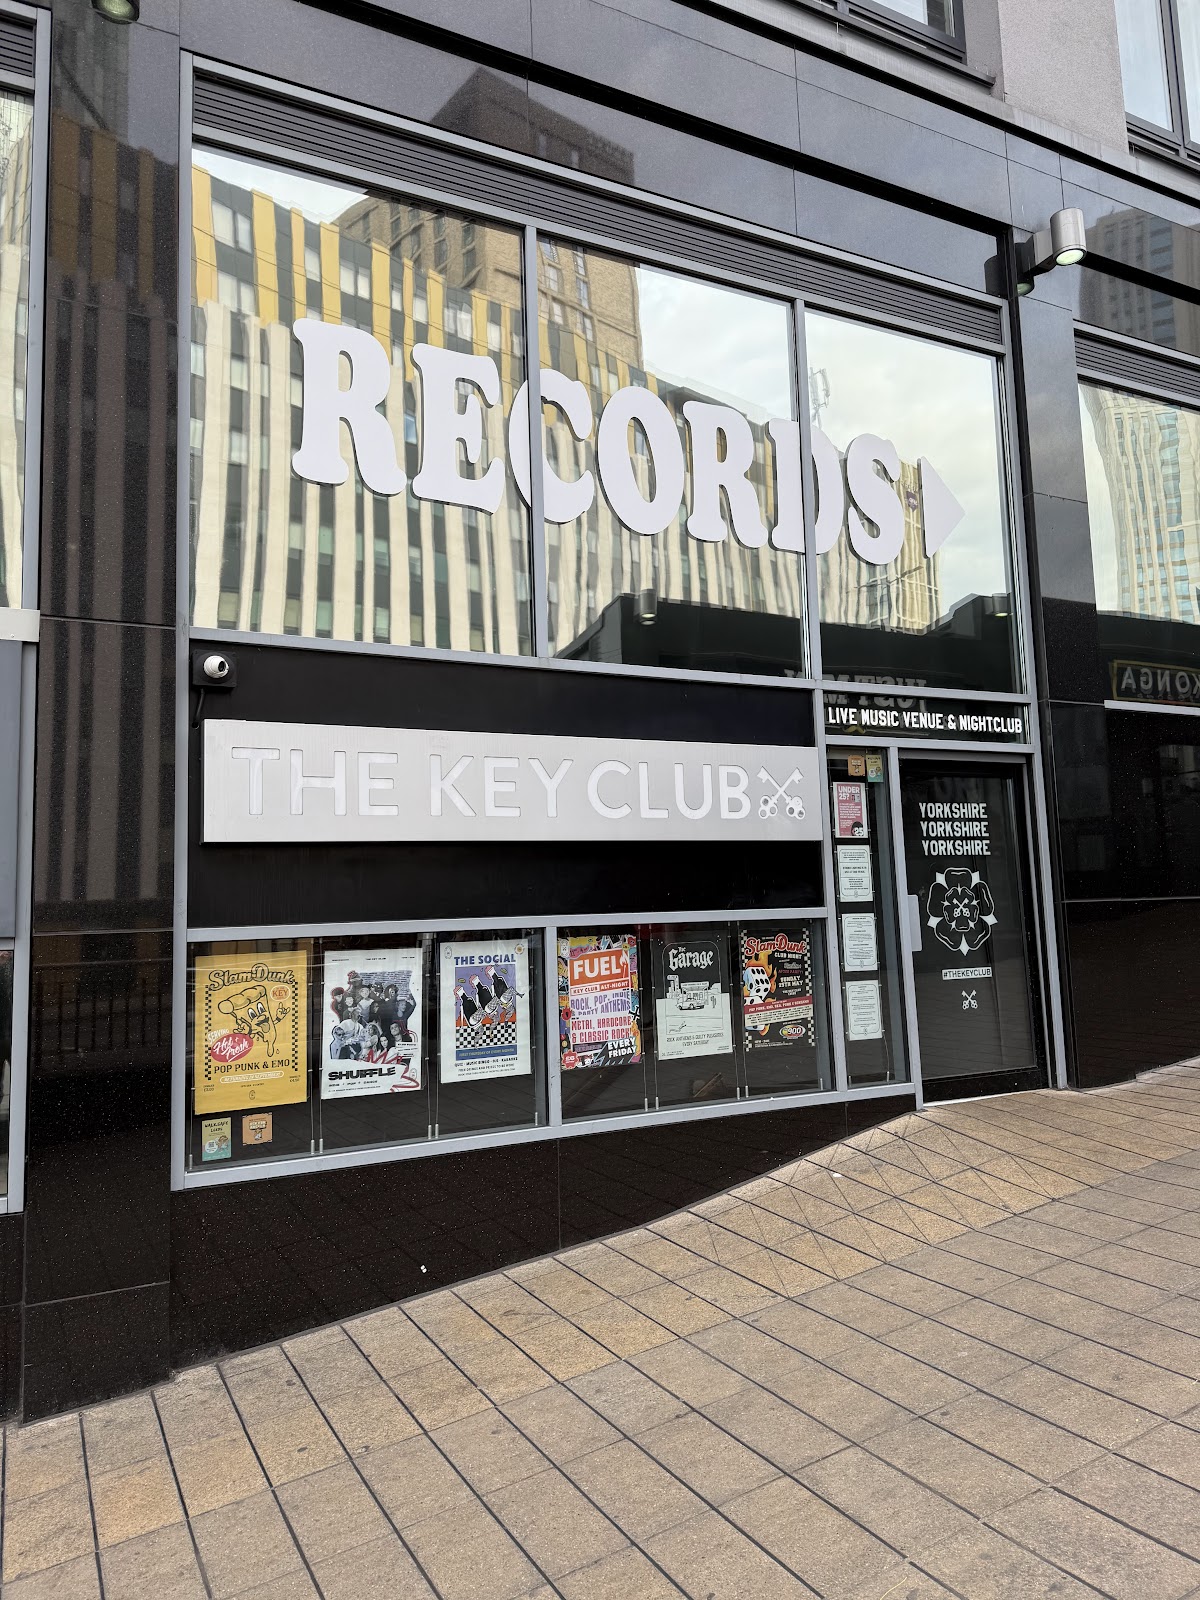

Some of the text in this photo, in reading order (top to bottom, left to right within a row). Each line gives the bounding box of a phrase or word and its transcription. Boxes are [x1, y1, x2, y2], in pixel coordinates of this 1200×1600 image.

[292, 319, 904, 565] RECORDS
[828, 707, 1022, 733] LIVE MUSIC VENUE & NIGHTCLUB
[231, 746, 751, 819] THE KEY CLUB
[838, 786, 860, 794] UNDER
[919, 803, 988, 818] YORKSHIRE
[920, 821, 989, 837] YORKSHIRE
[922, 840, 991, 856] YORKSHIRE
[745, 933, 807, 957] Slam Dunk
[454, 953, 516, 966] THE SOCIAL
[668, 949, 714, 971] Garage
[573, 956, 621, 980] FUEL
[943, 968, 992, 979] #THEKEYCLUB
[600, 981, 628, 990] ALT-NIGHT
[272, 989, 289, 998] KEY
[578, 1008, 598, 1016] PARTY
[601, 999, 631, 1014] ANTHEMS
[597, 1016, 632, 1029] HARDCORE
[579, 1030, 609, 1042] CLASSIC
[608, 1037, 636, 1050] EVERY
[608, 1046, 637, 1058] FRIDAY
[214, 1059, 290, 1074] POP PUNK & EMO
[328, 1067, 396, 1081] SHUFFLE
